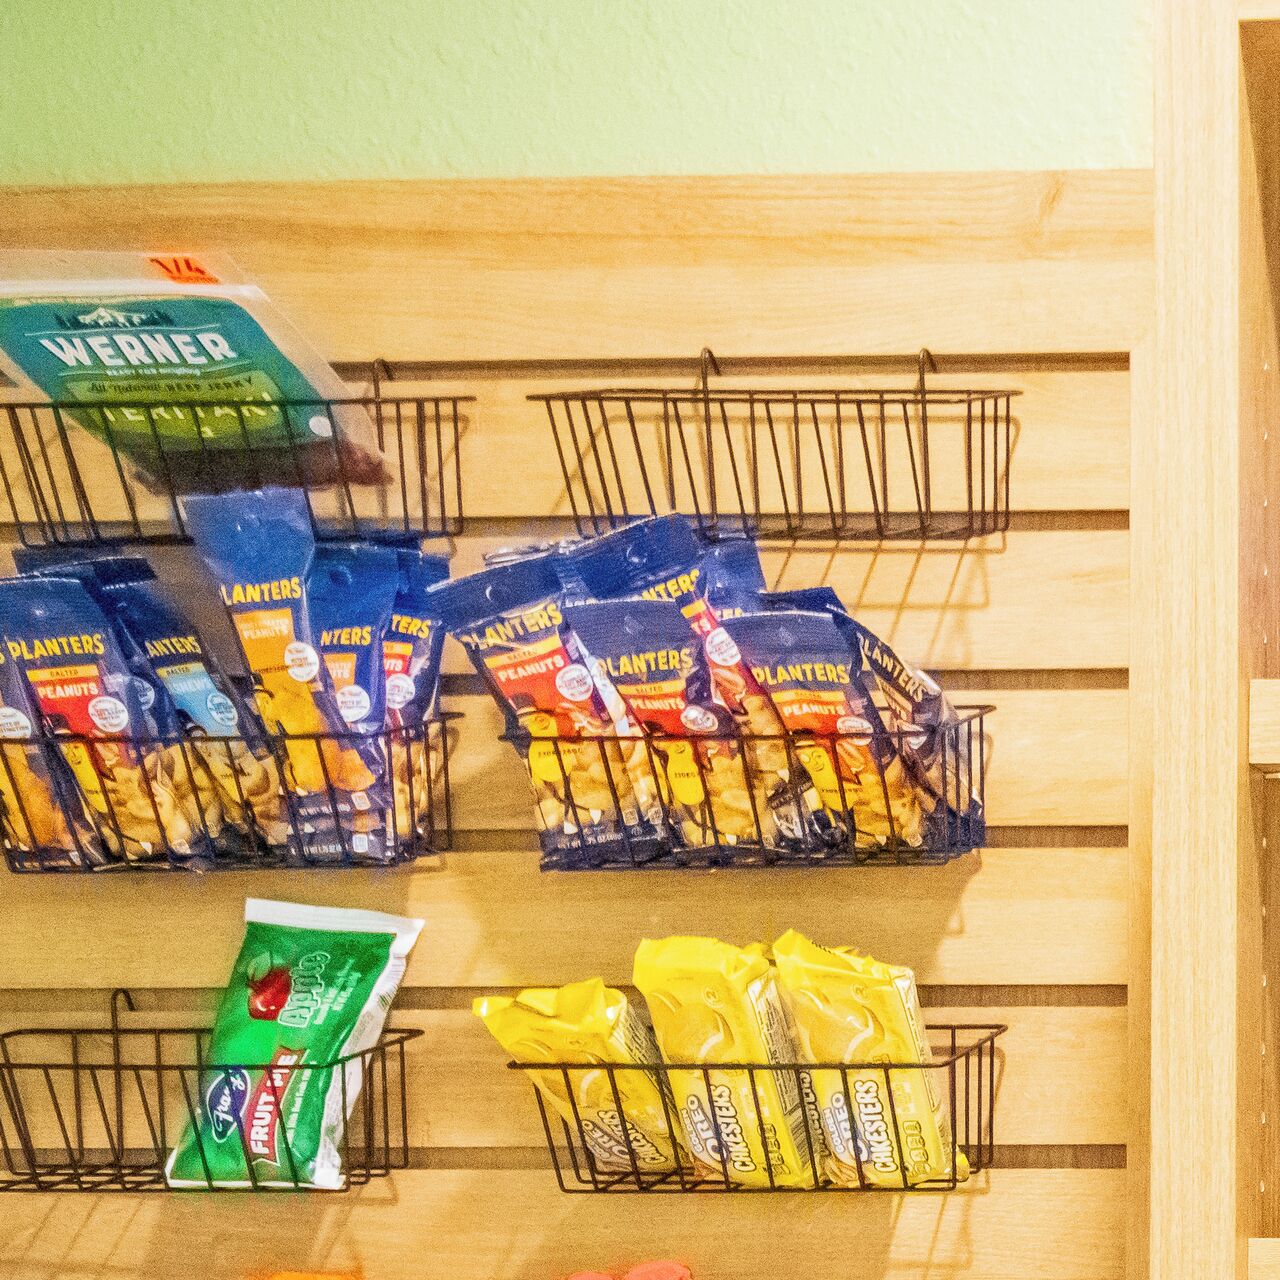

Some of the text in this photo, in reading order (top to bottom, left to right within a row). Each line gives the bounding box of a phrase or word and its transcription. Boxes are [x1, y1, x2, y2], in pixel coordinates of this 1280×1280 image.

[40, 332, 237, 367] WERNER
[7, 634, 105, 662] PLANTERS
[498, 655, 565, 683] PEANUTS
[599, 648, 693, 677] PLANTERS
[753, 663, 850, 686] PLANTERS
[37, 682, 99, 699] PEANUTS
[630, 698, 686, 711] PEANUTS
[783, 704, 847, 717] PEANUTS
[250, 1085, 277, 1156] FRUIT
[854, 1079, 899, 1174] CAKESTERS
